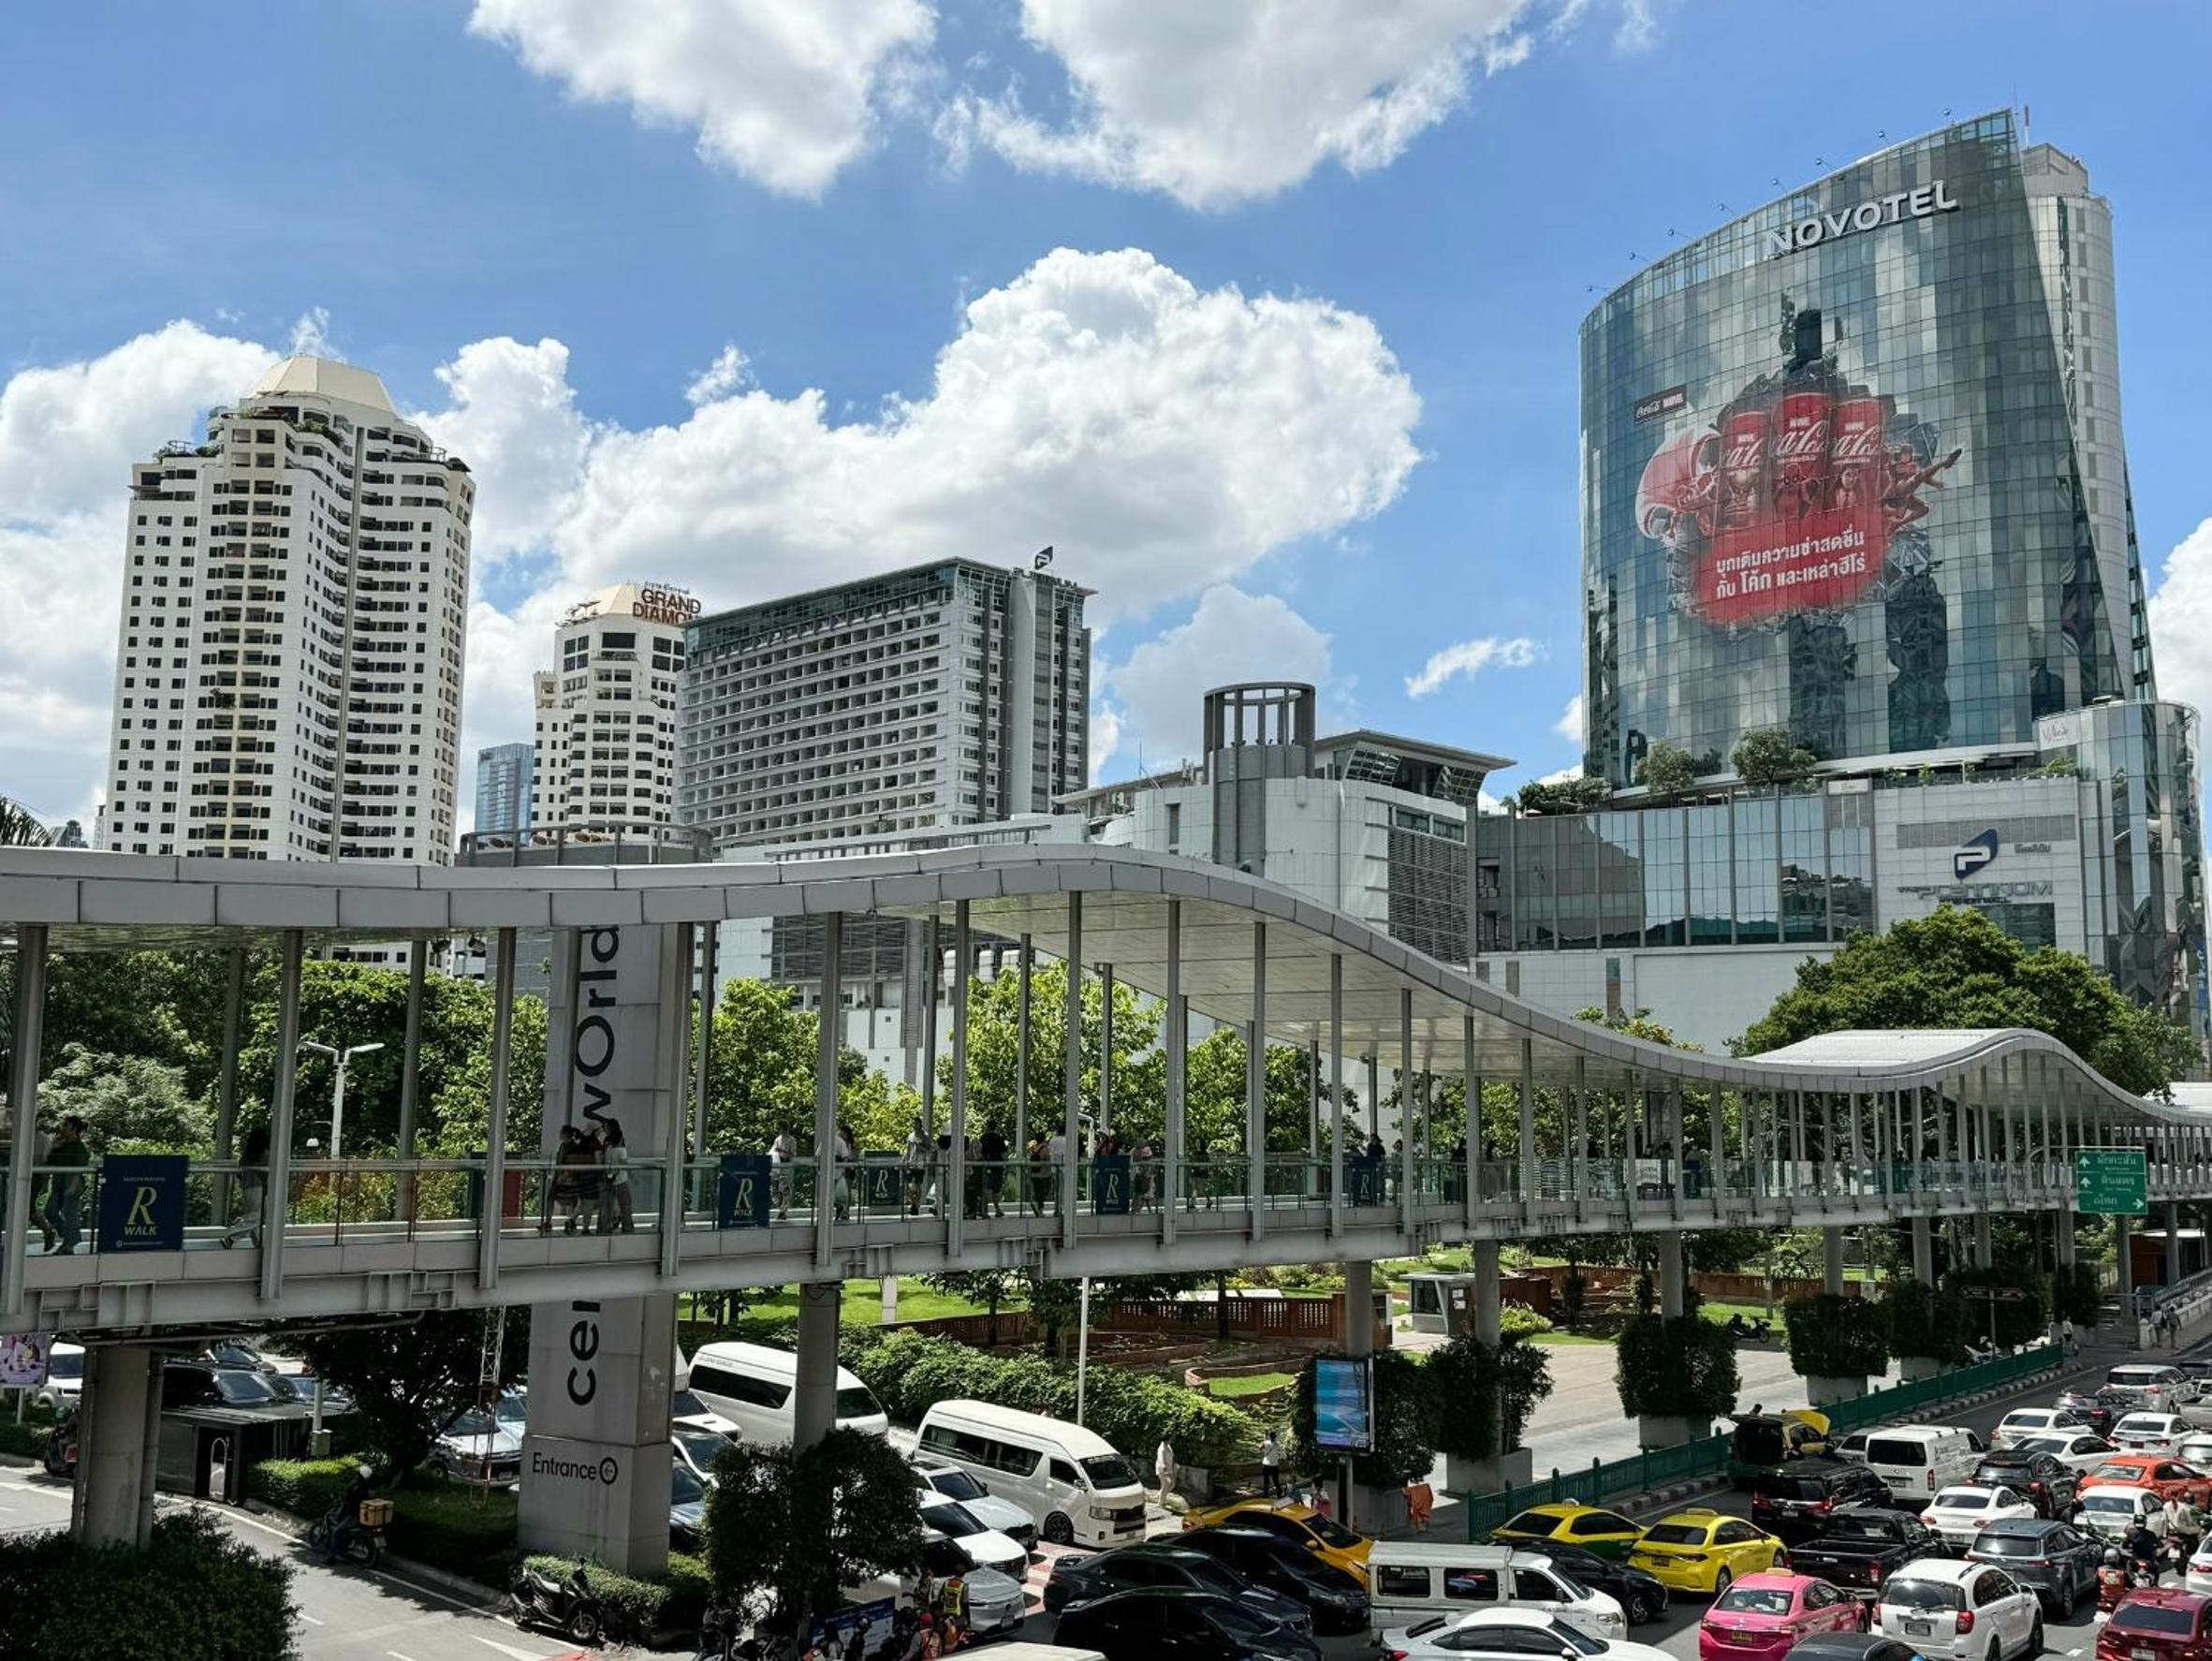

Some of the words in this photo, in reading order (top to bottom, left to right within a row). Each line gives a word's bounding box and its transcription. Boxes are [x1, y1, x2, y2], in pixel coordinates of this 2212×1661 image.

[1767, 180, 1957, 256] NOVOTEL
[1717, 580, 1736, 599] กับ
[1740, 567, 1772, 595] โค้ก
[1777, 552, 1867, 587] และเหล่าฮีโร่
[633, 601, 696, 625] DIAMO
[641, 588, 702, 615] GRAND
[736, 1178, 754, 1208] R
[876, 1169, 888, 1192] R
[1107, 1173, 1119, 1198] R
[127, 1186, 157, 1225] R
[125, 1226, 157, 1236] WALK
[532, 1452, 597, 1481] Entrance
